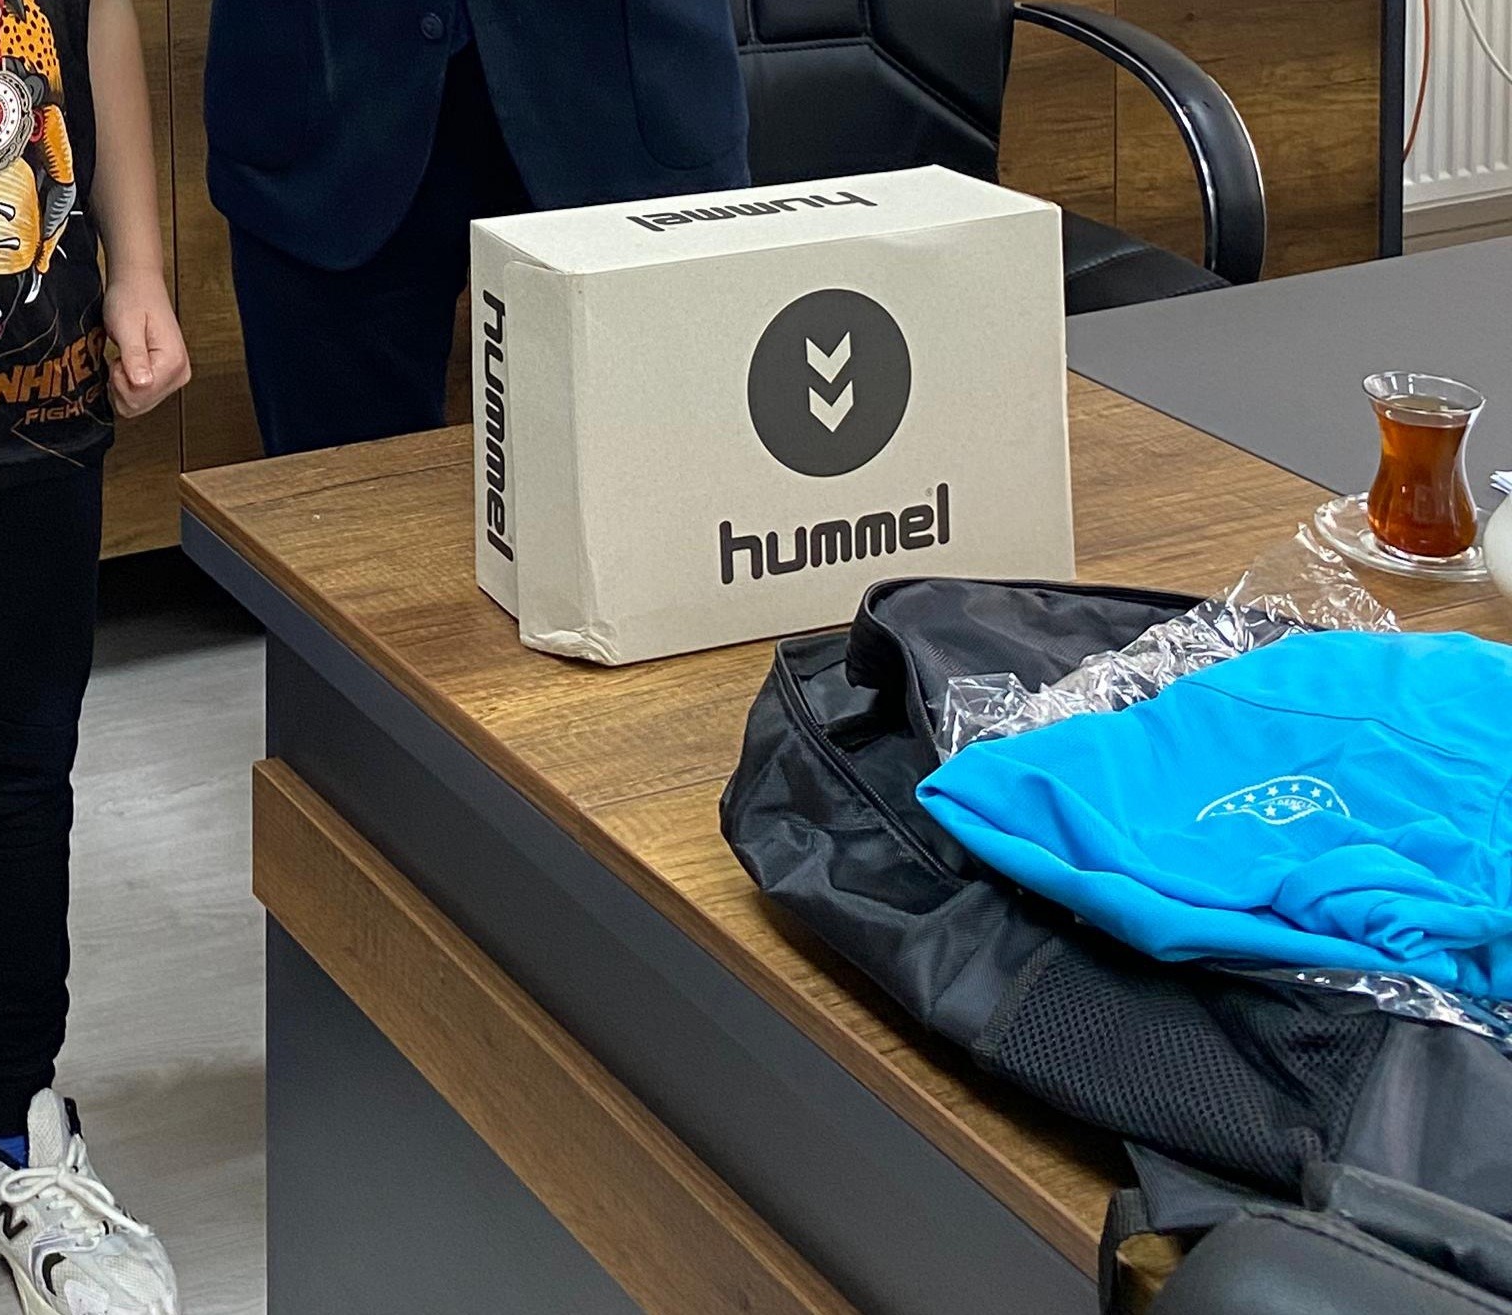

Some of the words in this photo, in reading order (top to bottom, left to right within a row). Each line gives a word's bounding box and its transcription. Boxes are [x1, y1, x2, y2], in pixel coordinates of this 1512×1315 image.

[626, 191, 878, 232] hummel
[482, 289, 514, 562] hummel
[719, 482, 950, 585] hummel
